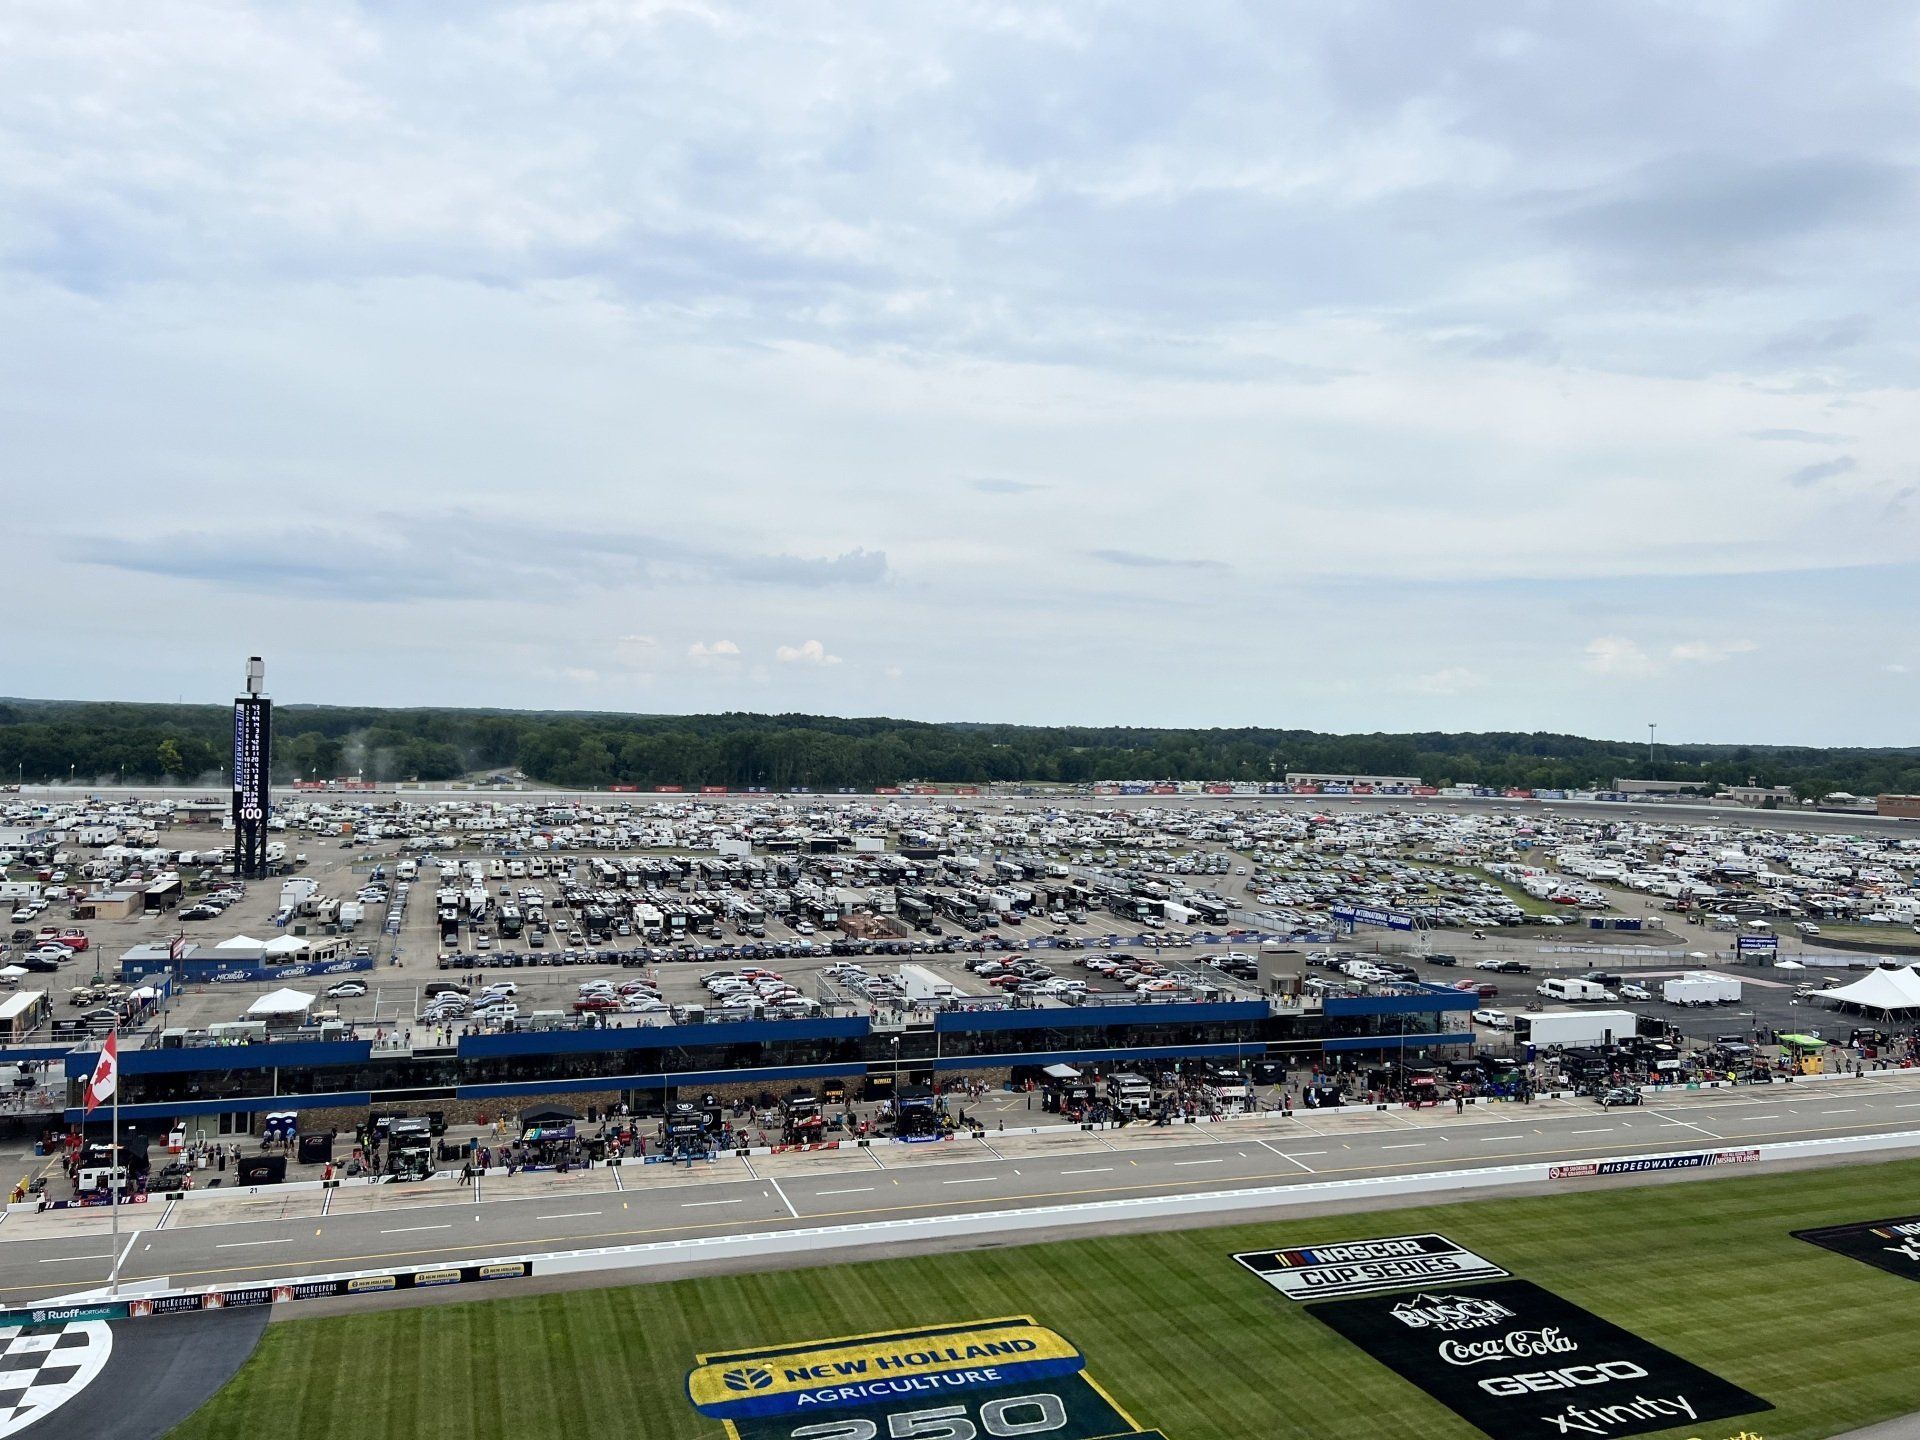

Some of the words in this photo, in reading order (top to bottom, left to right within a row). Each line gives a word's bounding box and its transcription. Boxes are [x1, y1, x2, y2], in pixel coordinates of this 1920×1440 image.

[239, 808, 263, 819] 100
[1355, 909, 1388, 921] INTERNATIONAL
[1389, 914, 1411, 925] SPEEDWAY
[281, 967, 306, 976] MICHIGAN
[329, 963, 351, 971] MICHIGAN
[217, 973, 245, 981] MICHIGAN
[1602, 1158, 1698, 1173] MISPEEDWAY.com
[67, 1200, 89, 1208] FedEx
[1311, 1240, 1427, 1263] NASCAR
[1300, 1268, 1363, 1286] CUP
[1366, 1257, 1462, 1280] SERIES
[48, 1308, 79, 1319] Ruoff
[80, 1308, 110, 1316] MORTGAGE
[1389, 1300, 1517, 1328] BUSCH
[1438, 1327, 1578, 1366] Coca-Cola
[784, 1359, 868, 1382] NEW
[876, 1339, 1037, 1370] HOLLAND
[797, 1368, 1003, 1406] AGRICULTURE
[1477, 1360, 1649, 1396] GEICO
[1541, 1395, 1698, 1435] xfinity
